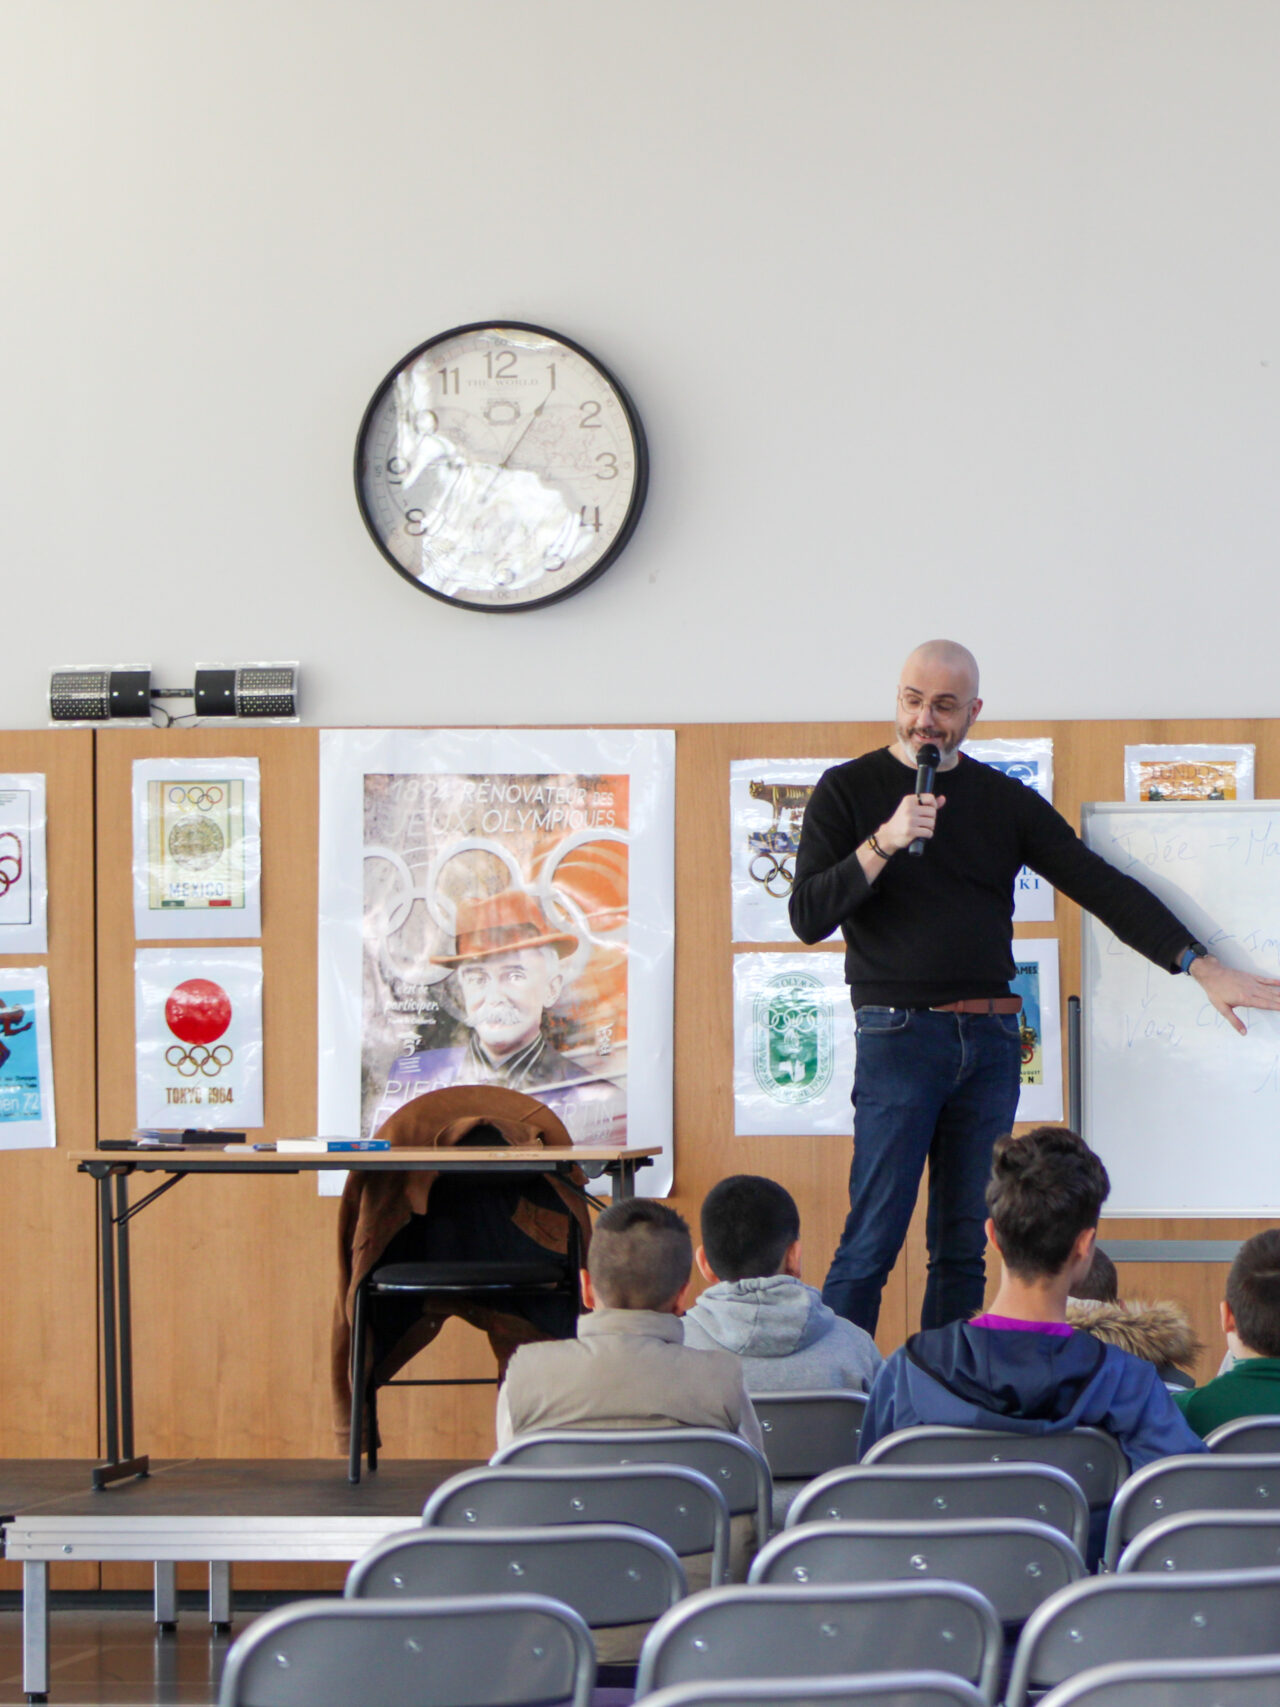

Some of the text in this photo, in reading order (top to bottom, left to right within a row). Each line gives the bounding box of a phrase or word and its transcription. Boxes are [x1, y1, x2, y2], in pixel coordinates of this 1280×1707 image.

[483, 351, 519, 379] 12
[546, 363, 556, 391] 1
[438, 367, 460, 395] 11
[579, 400, 602, 429] 2
[595, 452, 619, 480] 3
[404, 508, 427, 537] 8
[579, 505, 603, 533] 4
[390, 778, 615, 806] 1894 RÉNOVATEUR DES
[384, 808, 616, 838] JEUX OLYMPIQUES
[1112, 831, 1199, 869] Idée
[169, 882, 224, 897] MEXICO
[166, 1087, 234, 1104] TOKYO 1964
